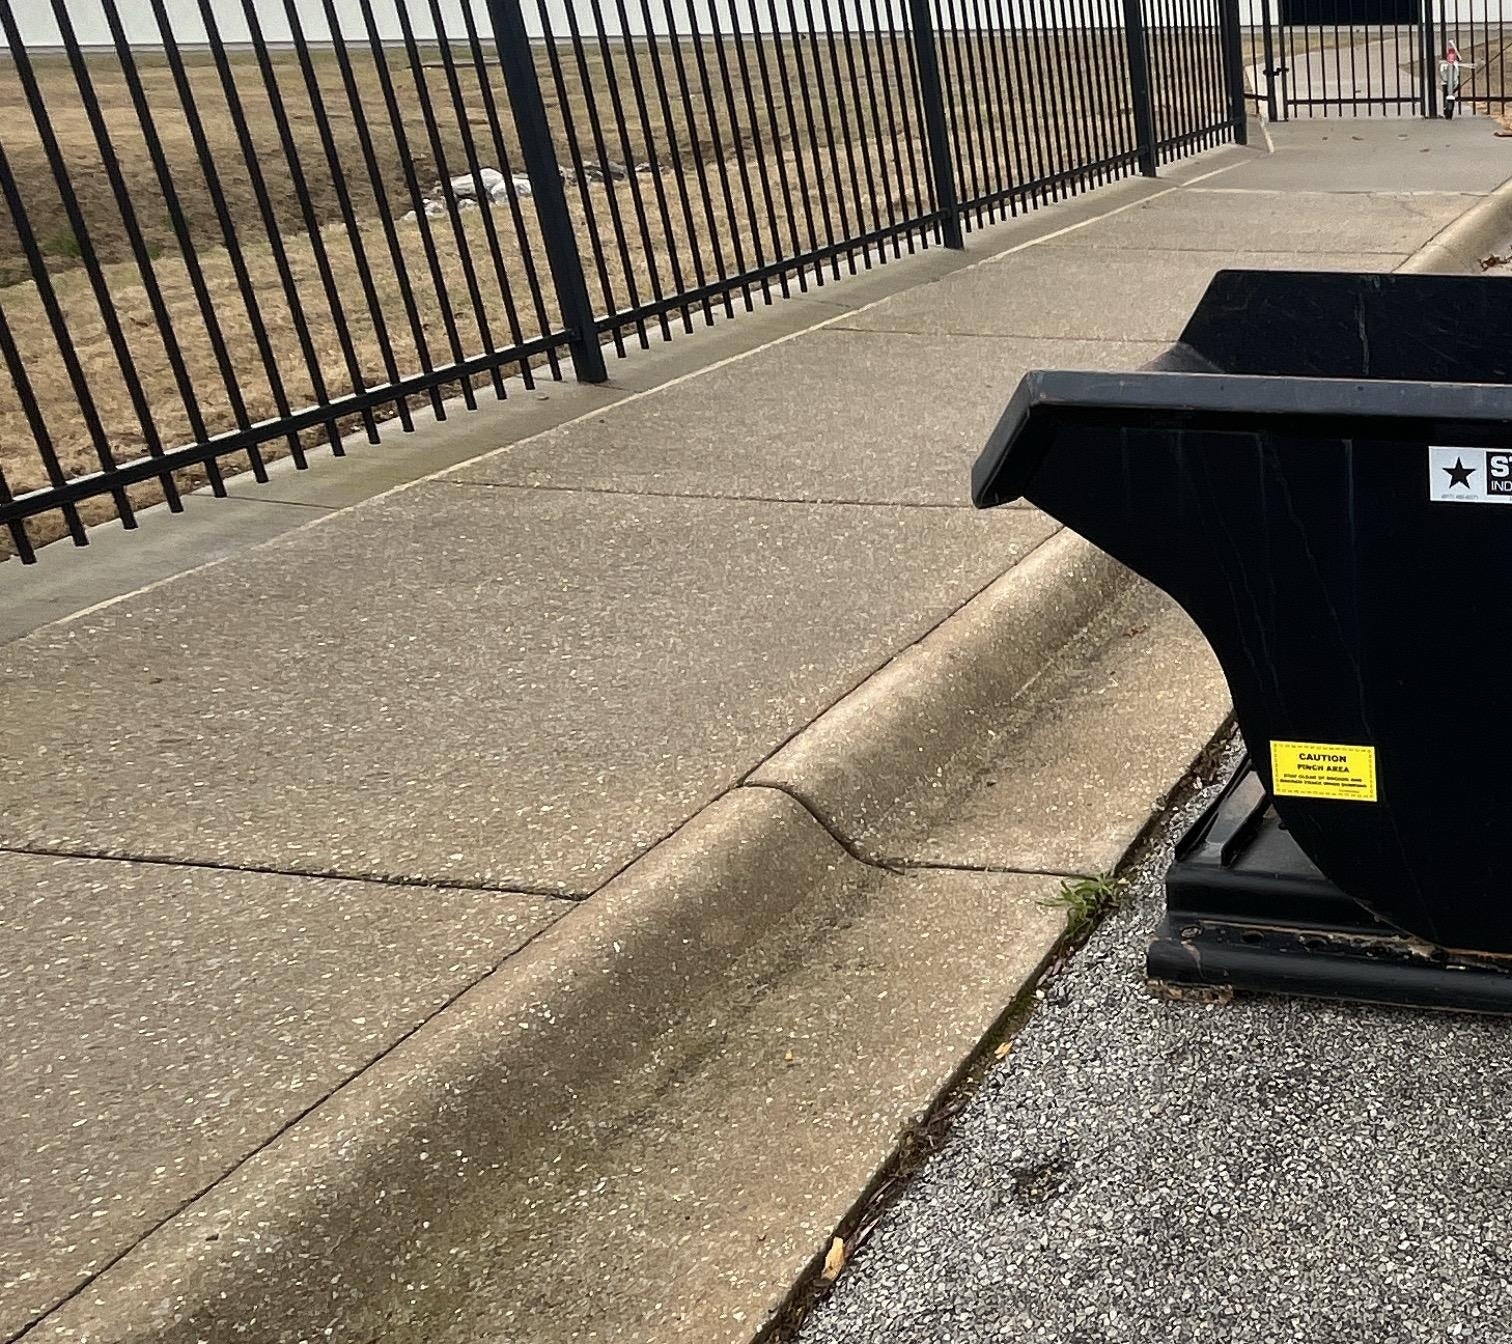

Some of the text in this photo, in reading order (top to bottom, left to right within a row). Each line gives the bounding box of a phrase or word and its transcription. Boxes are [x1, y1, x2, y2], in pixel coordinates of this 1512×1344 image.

[1299, 753, 1347, 763] CAUTION
[1297, 763, 1350, 773] PINCH AREA
